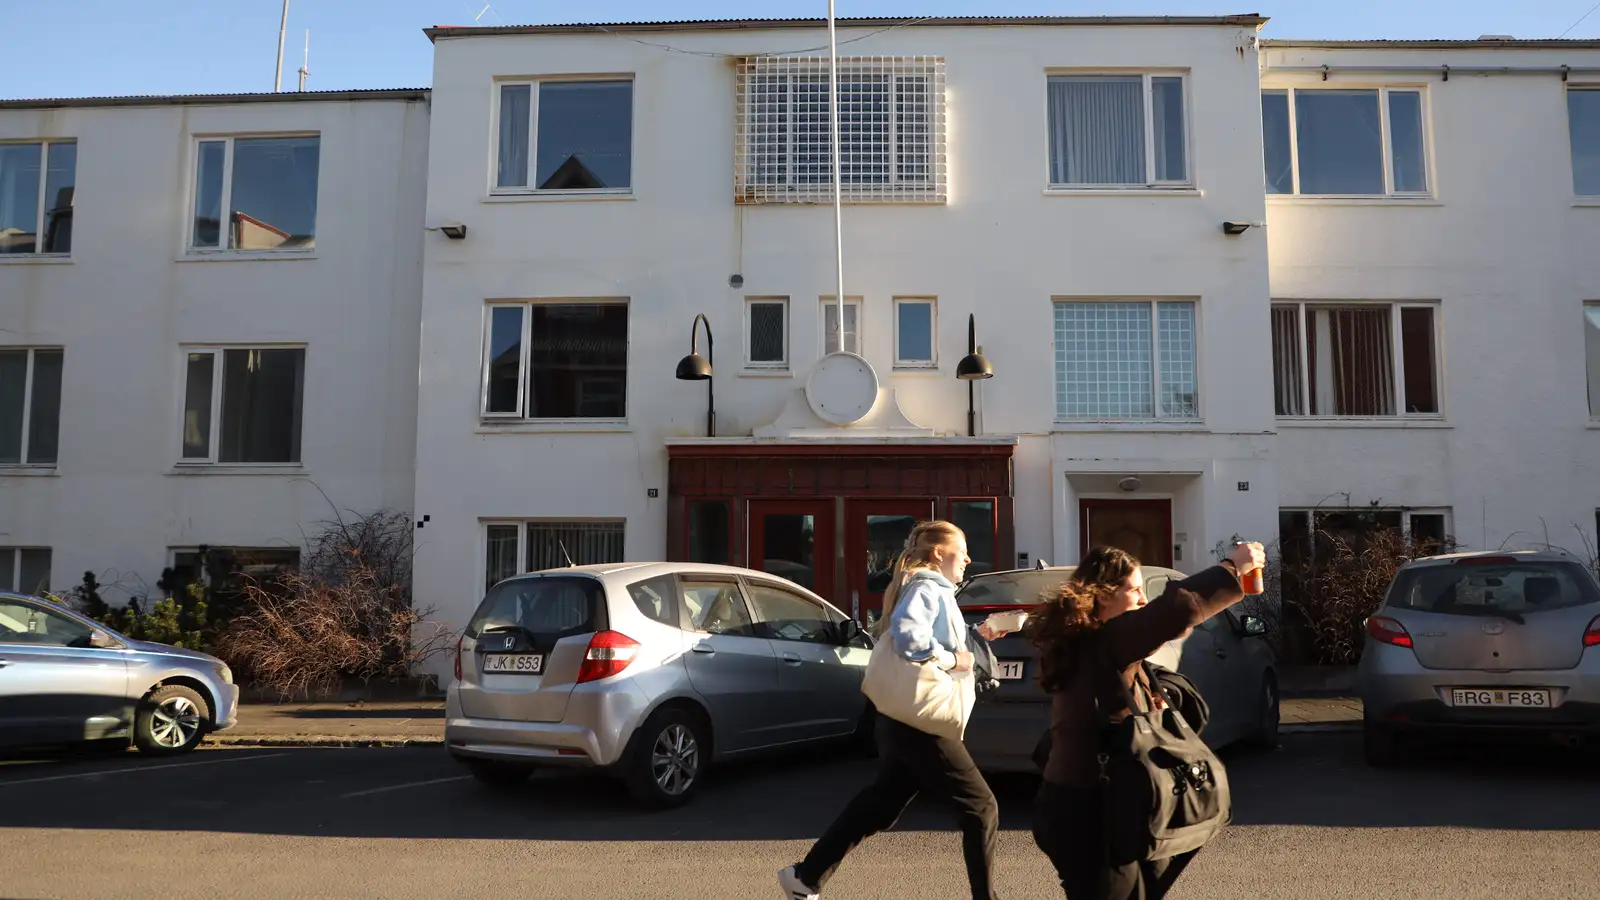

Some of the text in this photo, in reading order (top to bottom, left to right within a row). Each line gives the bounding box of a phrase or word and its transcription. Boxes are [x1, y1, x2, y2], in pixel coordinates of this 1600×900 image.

[493, 656, 509, 669] JK
[516, 656, 540, 670] S53
[997, 663, 1018, 677] 11
[1464, 692, 1545, 706] RG F83
